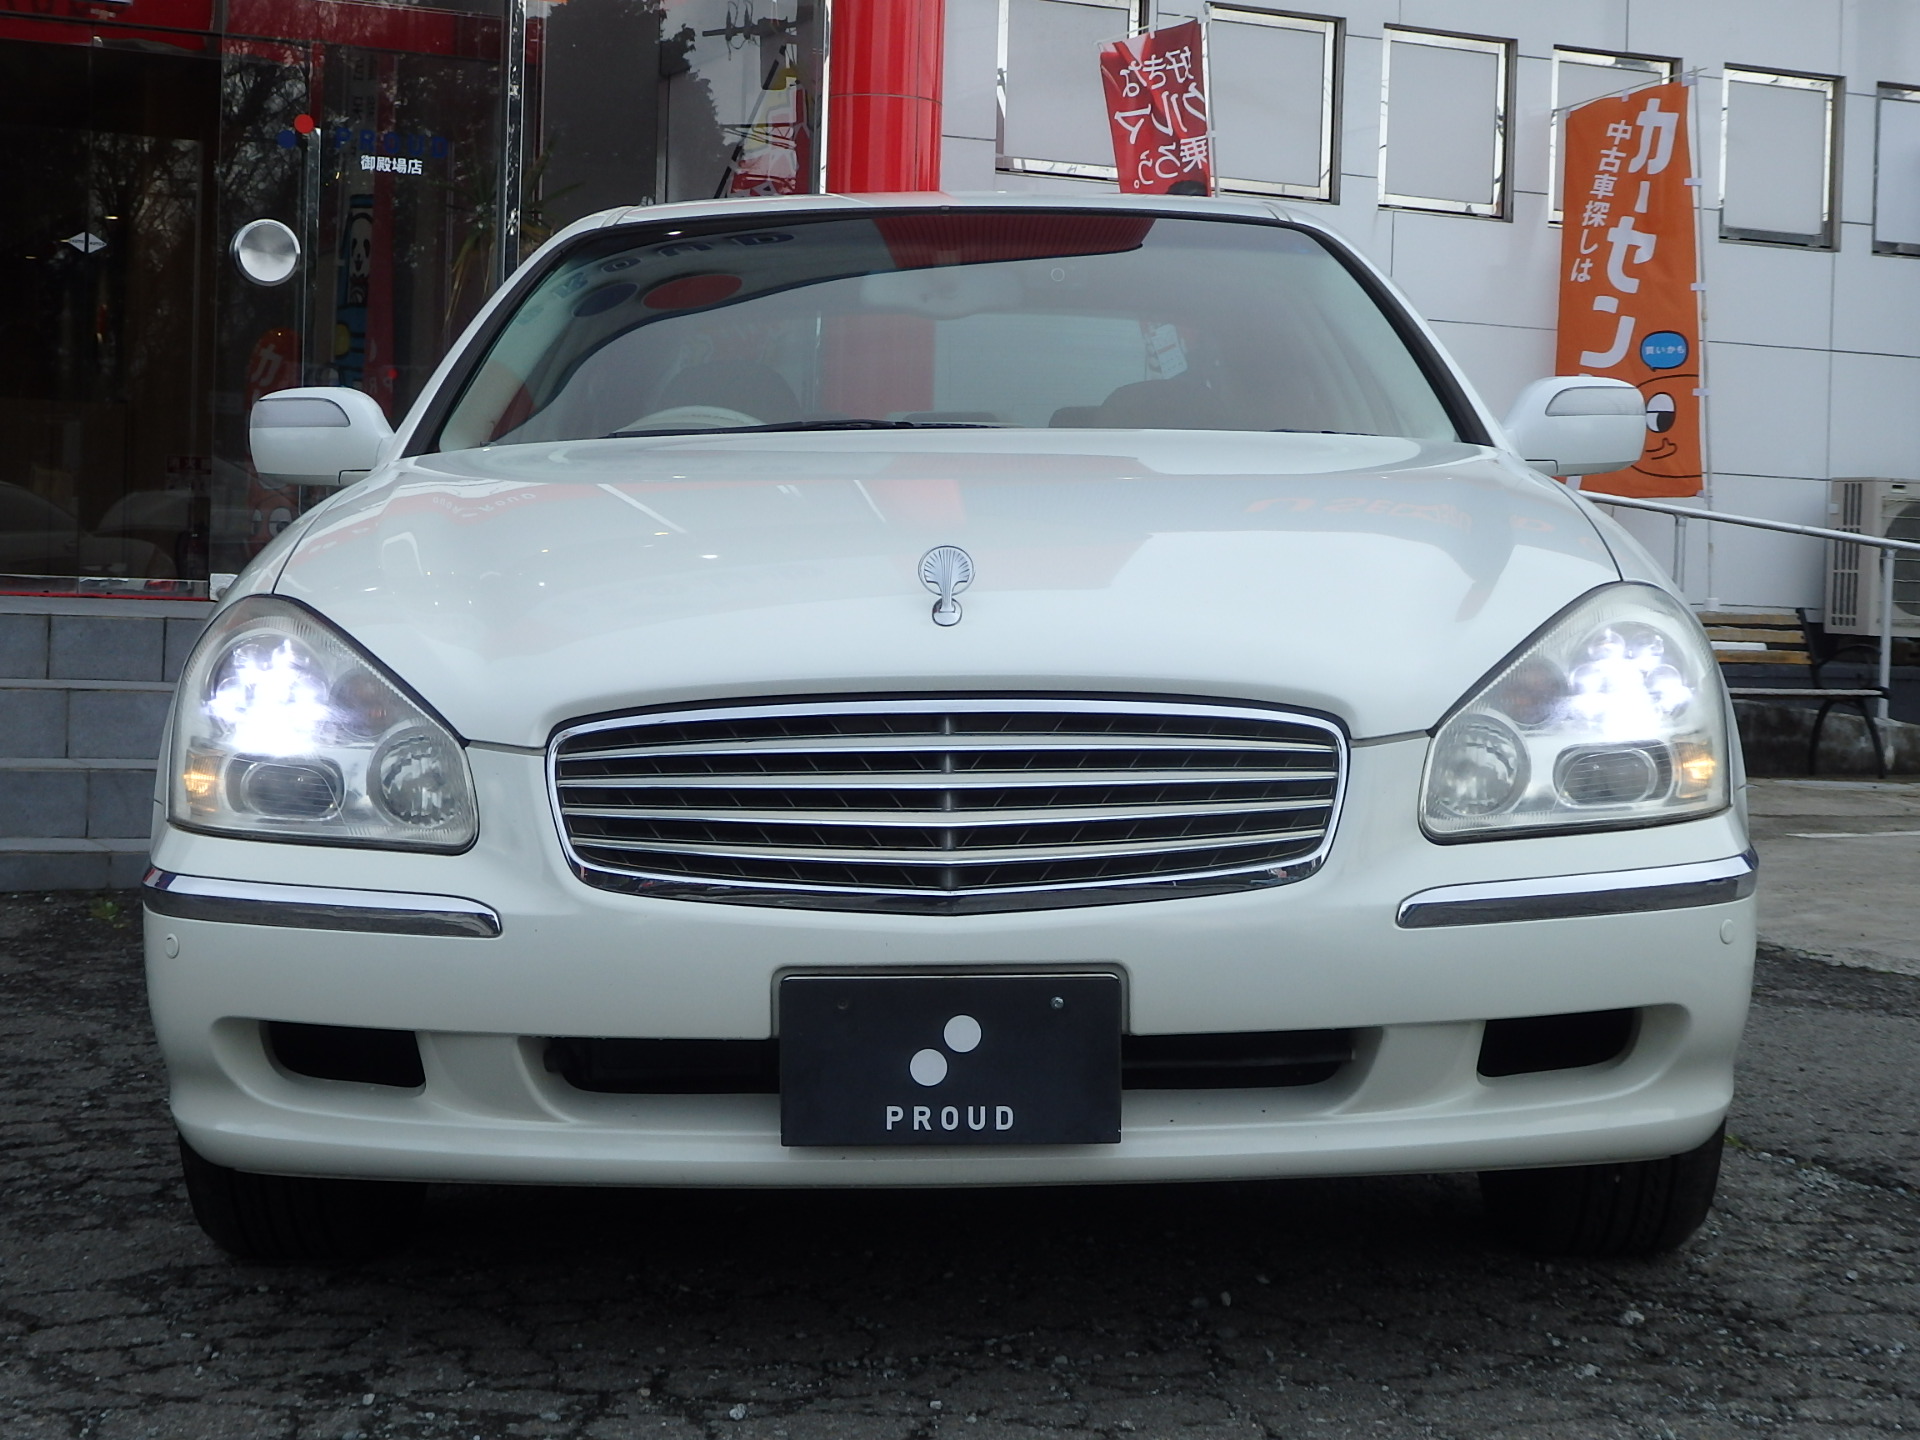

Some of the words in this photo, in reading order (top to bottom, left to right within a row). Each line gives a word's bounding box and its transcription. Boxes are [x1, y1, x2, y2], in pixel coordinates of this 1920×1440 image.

[335, 127, 449, 159] PROUD
[360, 155, 423, 175] 御殿場店
[1570, 119, 1633, 283] 中古車探しは
[1577, 98, 1680, 377] カーセン
[885, 1105, 1015, 1131] PROUD
